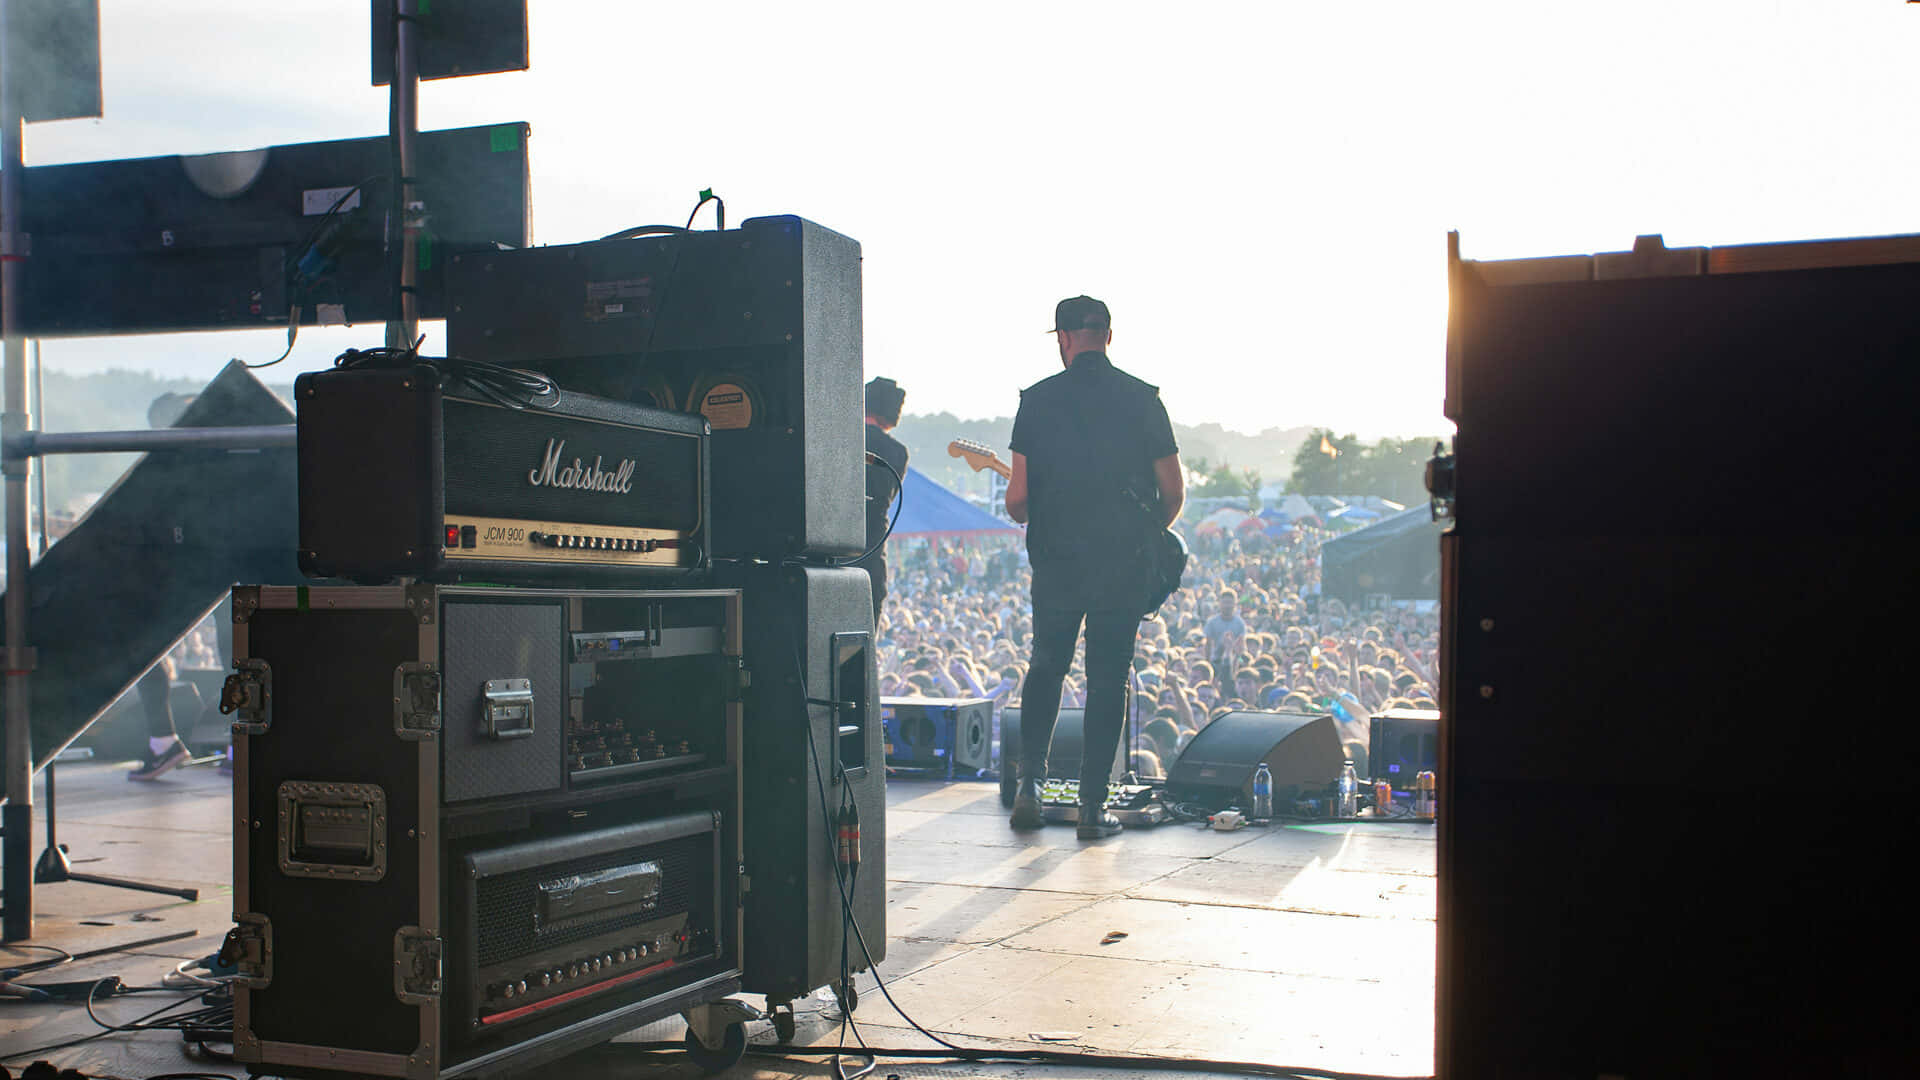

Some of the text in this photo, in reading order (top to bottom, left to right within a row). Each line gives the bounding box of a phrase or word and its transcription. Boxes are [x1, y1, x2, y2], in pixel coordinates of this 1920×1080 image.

[529, 437, 636, 494] Marshall
[483, 526, 505, 540] JCM
[507, 527, 525, 541] 900
